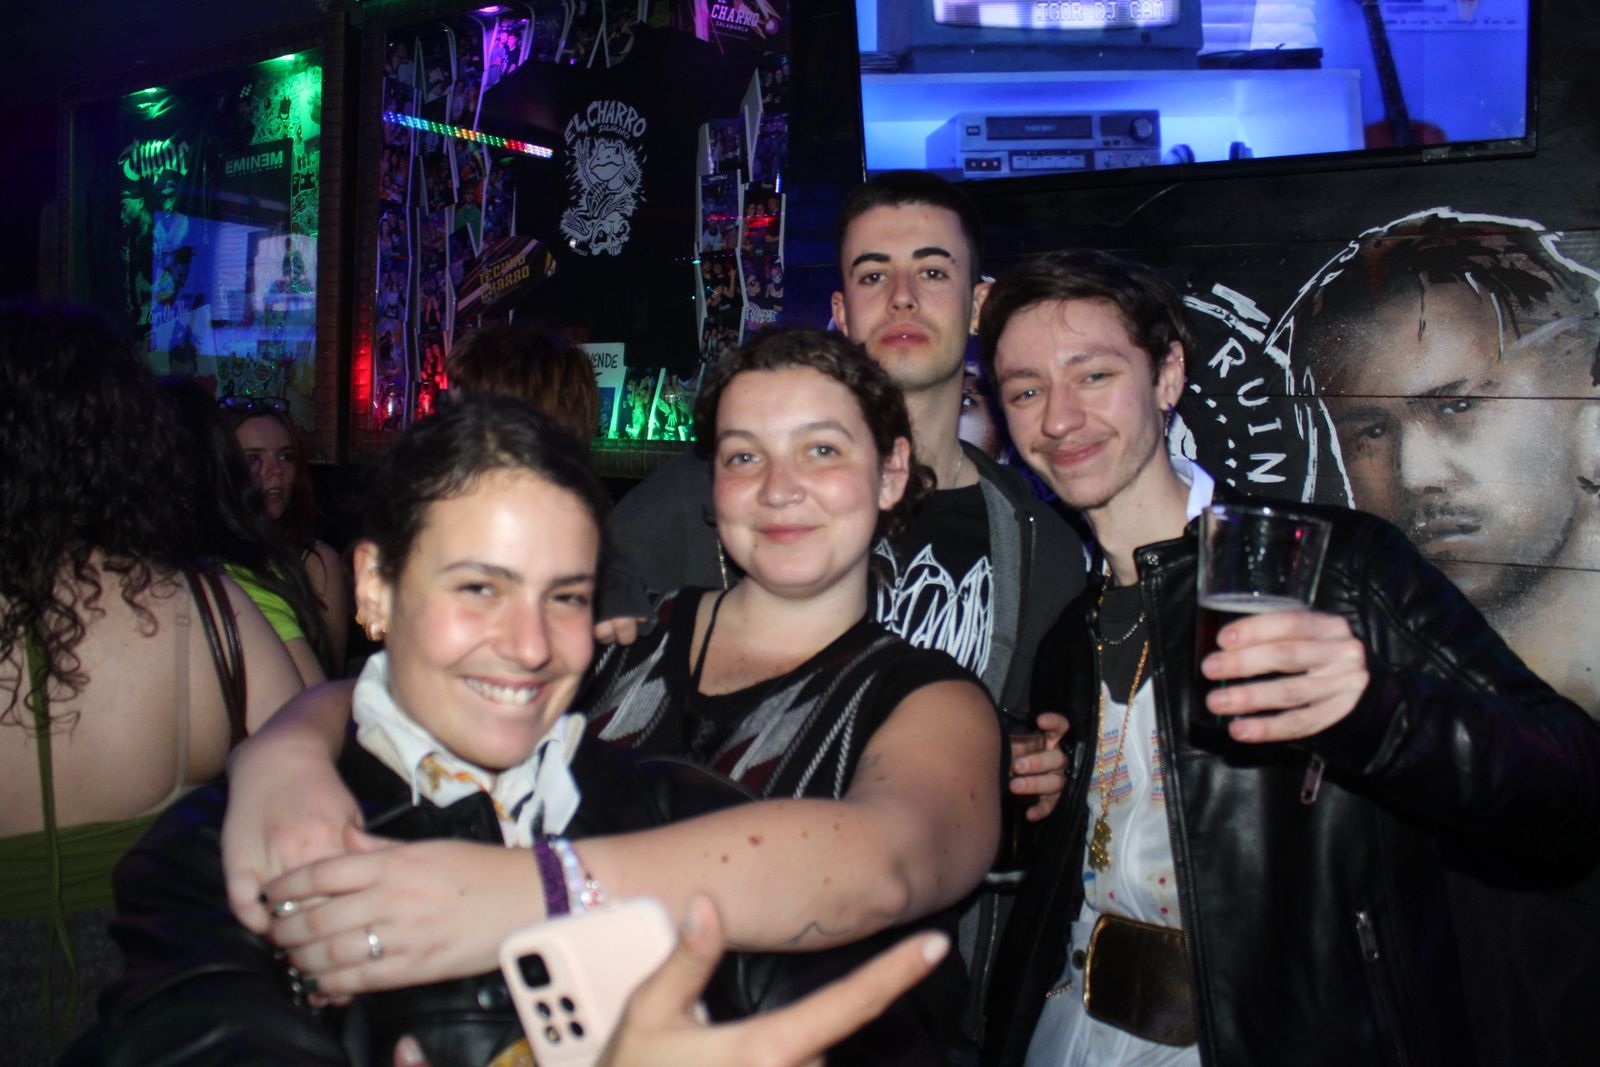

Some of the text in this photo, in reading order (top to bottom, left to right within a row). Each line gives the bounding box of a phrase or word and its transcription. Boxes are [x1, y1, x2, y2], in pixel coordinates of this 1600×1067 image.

[711, 4, 760, 27] CHARRO
[1037, 3, 1083, 21] IGOR
[1094, 1, 1117, 20] DJ
[586, 99, 647, 138] CHARRO
